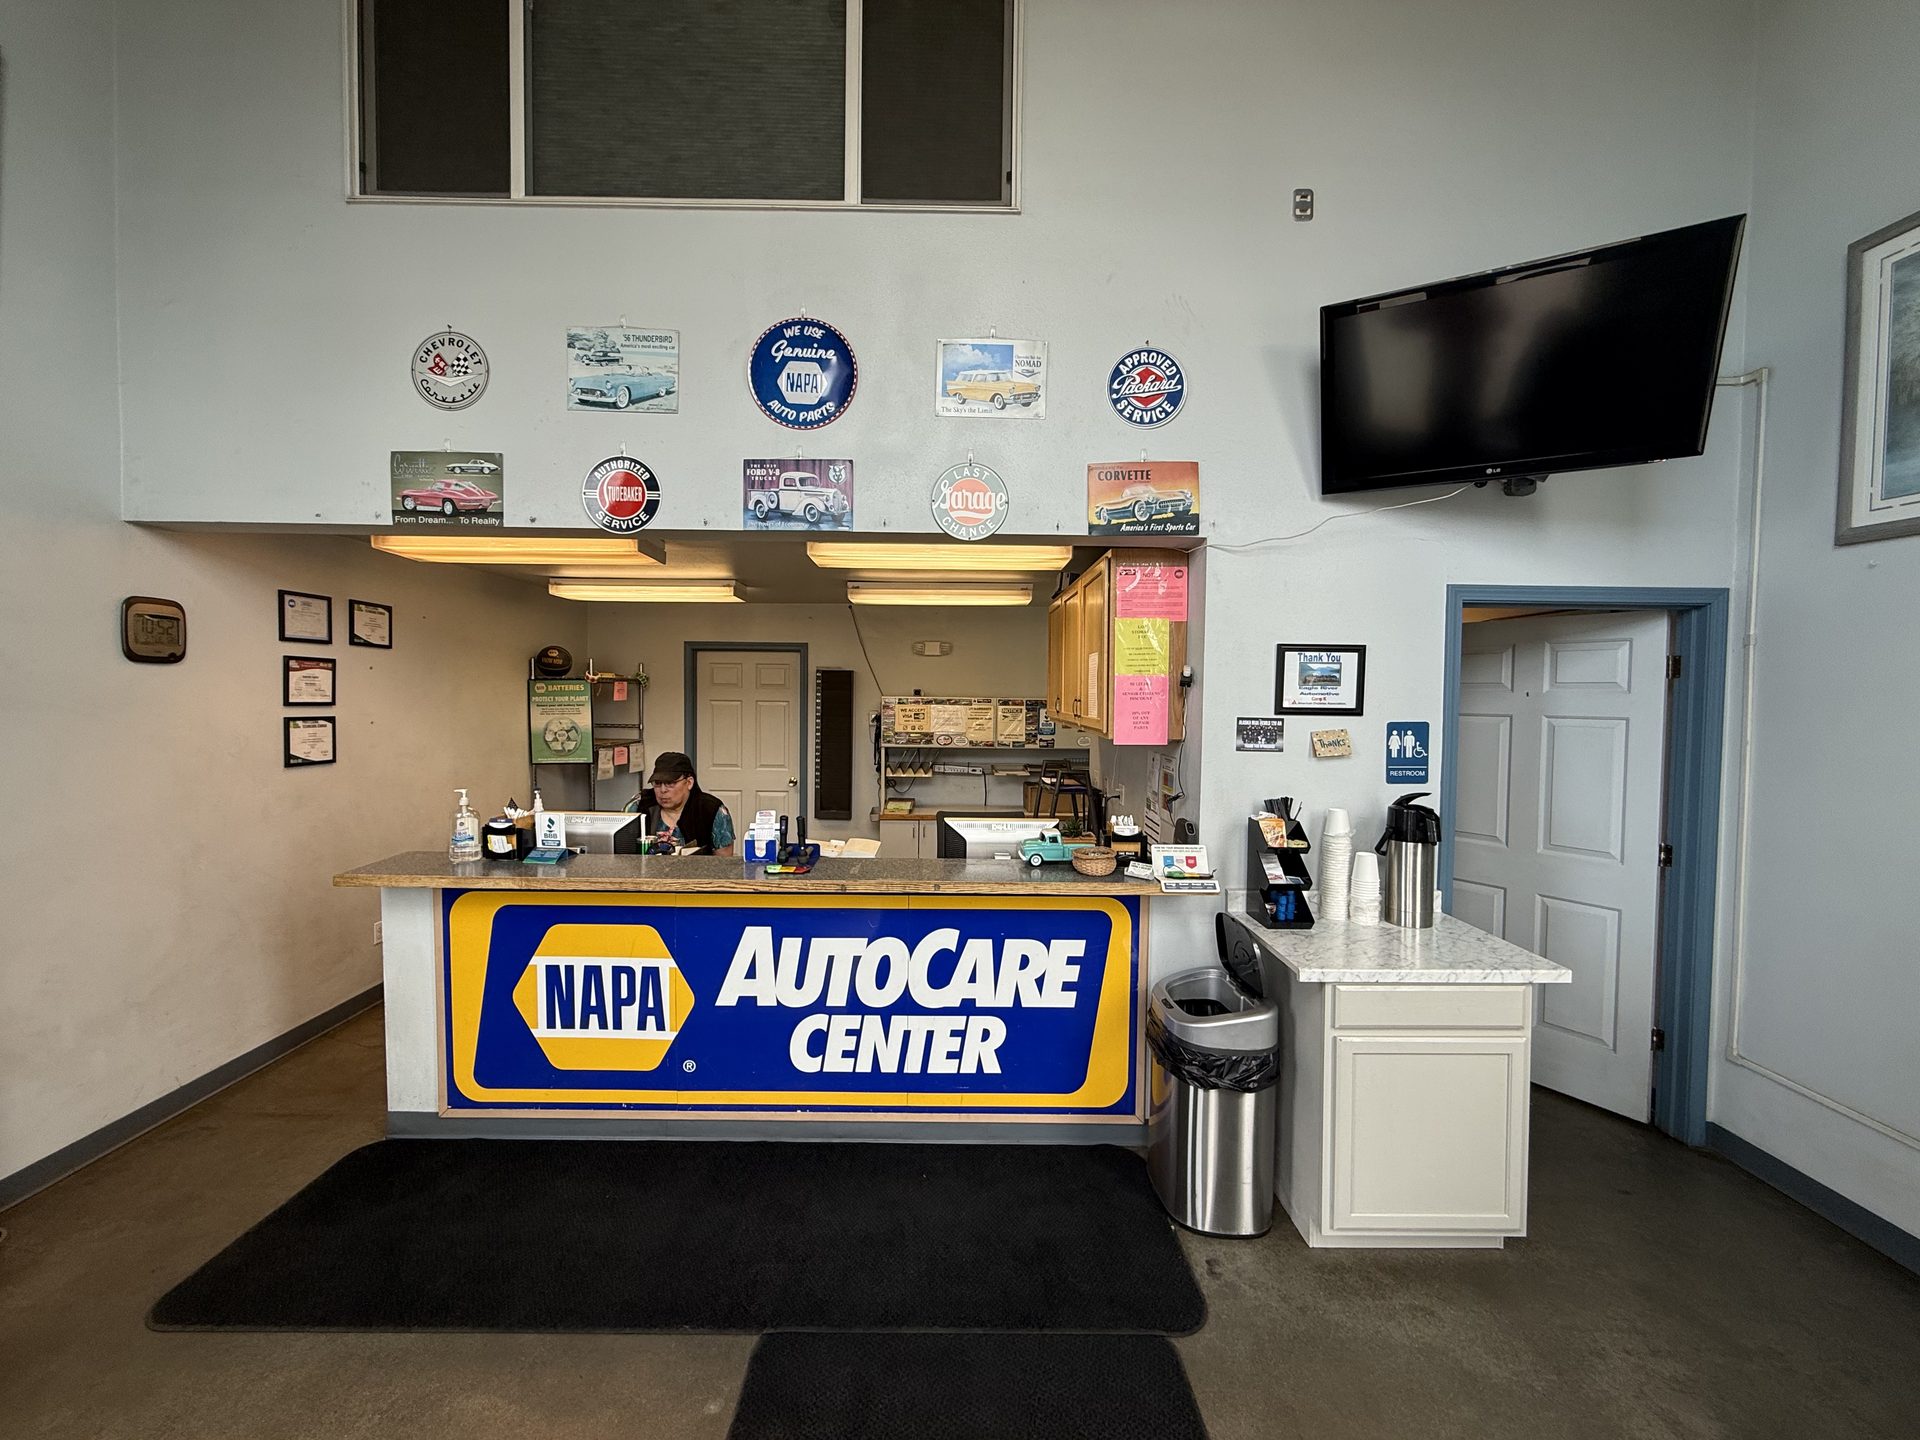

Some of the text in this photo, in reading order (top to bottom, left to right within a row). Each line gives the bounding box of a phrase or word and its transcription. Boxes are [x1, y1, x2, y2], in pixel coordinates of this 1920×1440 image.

[632, 334, 673, 344] THUNDERBIRD
[783, 325, 825, 339] WE USE
[419, 337, 482, 363] CHEVROLET
[771, 340, 837, 363] Genuine
[1015, 360, 1042, 368] NOMAD
[1119, 352, 1177, 374] APPROVED
[786, 372, 819, 393] NAPA
[1112, 374, 1182, 398] Packard
[767, 400, 836, 422] AUTO PARTS
[1116, 399, 1174, 423] SERVICE
[594, 460, 651, 481] AUTHORIZED
[746, 468, 780, 476] FORD V-8
[953, 467, 989, 480] LAST
[1097, 469, 1151, 481] CORVETTE
[932, 480, 1006, 518] Garage
[395, 516, 500, 527] From Dream... To Reality
[595, 510, 649, 529] SERVICE
[942, 517, 995, 537] CHANCE
[1120, 523, 1196, 533] America's First Sports Car
[1298, 652, 1341, 663] Thank You
[545, 964, 667, 1032] NAPA
[788, 1015, 1007, 1075] CENTER
